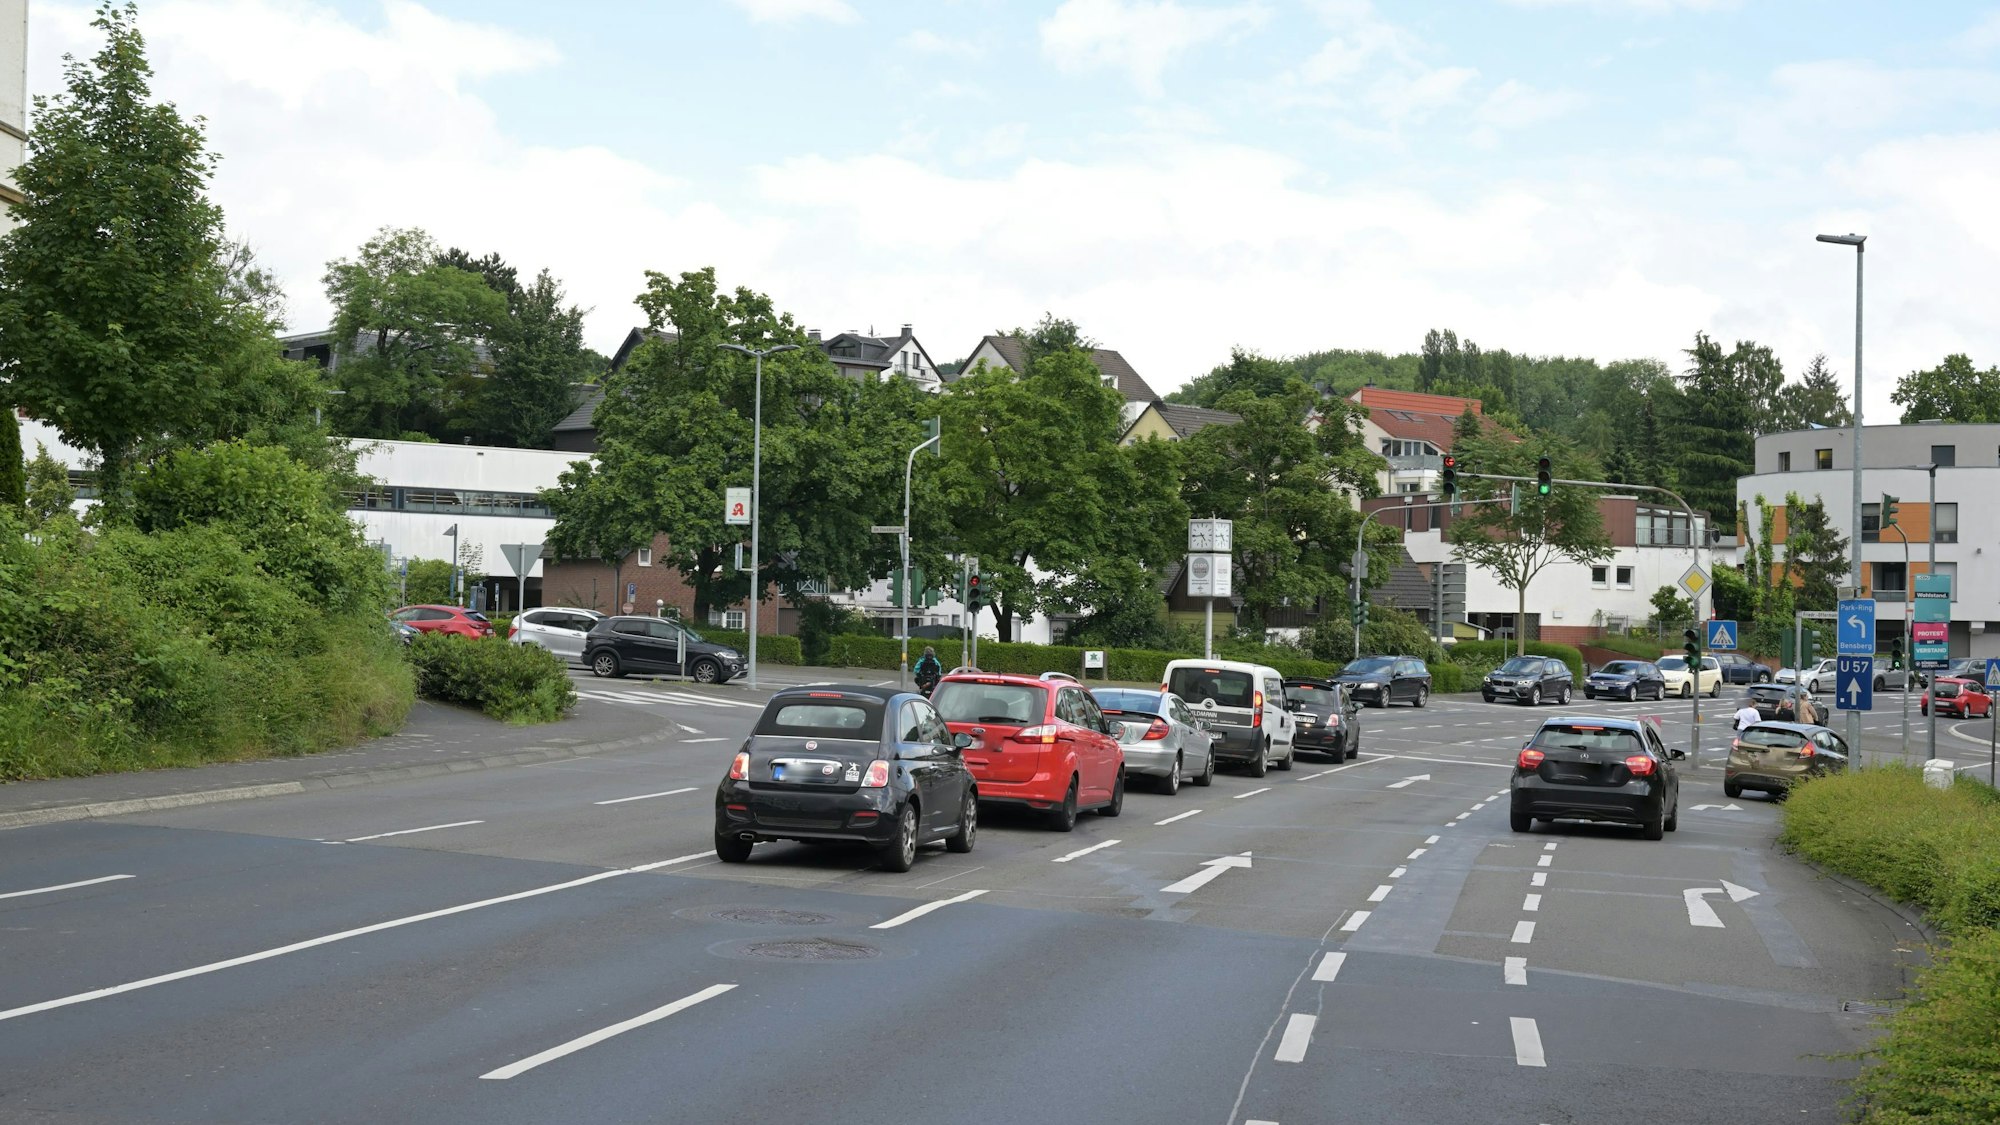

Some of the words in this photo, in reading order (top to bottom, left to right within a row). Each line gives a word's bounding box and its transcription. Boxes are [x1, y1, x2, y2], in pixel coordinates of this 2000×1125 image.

[1840, 604, 1872, 612] Park-Ring
[1840, 642, 1872, 650] Bensberg
[1852, 660, 1869, 672] 57
